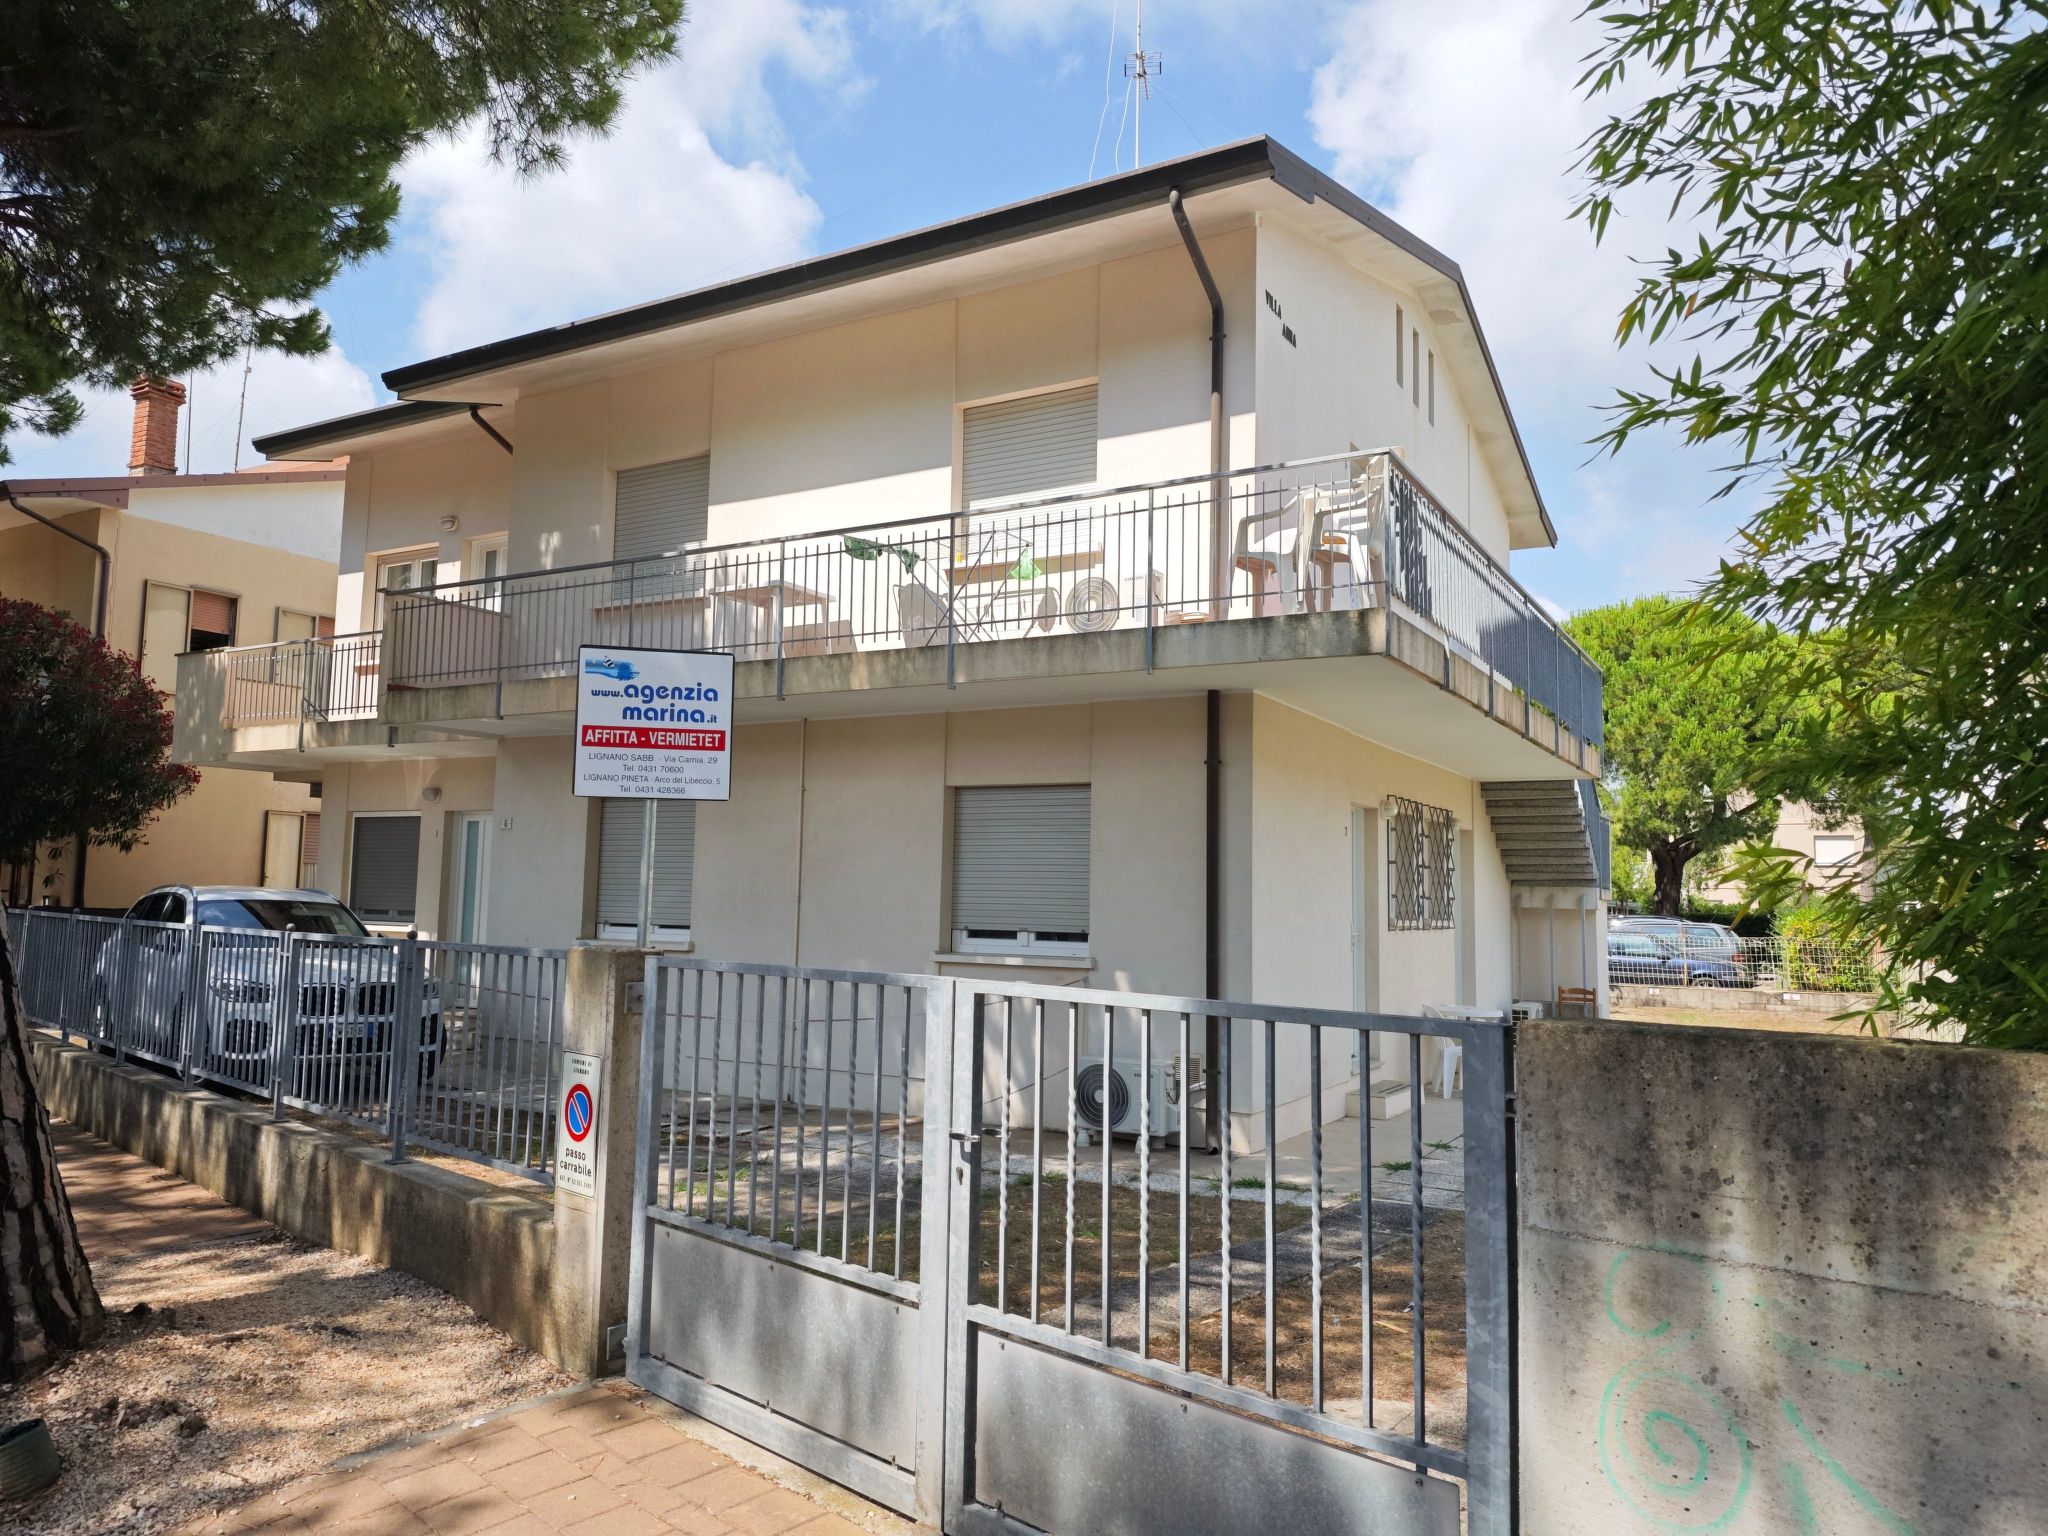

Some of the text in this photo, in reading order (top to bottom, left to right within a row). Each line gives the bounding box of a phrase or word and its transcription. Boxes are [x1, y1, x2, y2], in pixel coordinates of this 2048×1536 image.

[1264, 289, 1282, 320] VILLA
[591, 682, 719, 705] www.agenzia
[622, 703, 718, 724] marina.it
[585, 729, 638, 745] AFFITTA
[649, 731, 721, 748] VERMIETET
[588, 752, 629, 762] LIGNANO
[664, 755, 677, 763] Via
[707, 756, 718, 765] 29
[637, 764, 657, 773] 0431
[660, 765, 685, 774] 70600
[583, 773, 620, 782] LIGNANO
[621, 774, 649, 783] PINETA
[655, 775, 671, 784] Arco
[672, 776, 683, 785] del
[716, 777, 721, 786] 5
[635, 785, 654, 794] 0431
[656, 786, 687, 795] 428366
[565, 1147, 586, 1161] passo
[559, 1160, 592, 1178] carrabile
